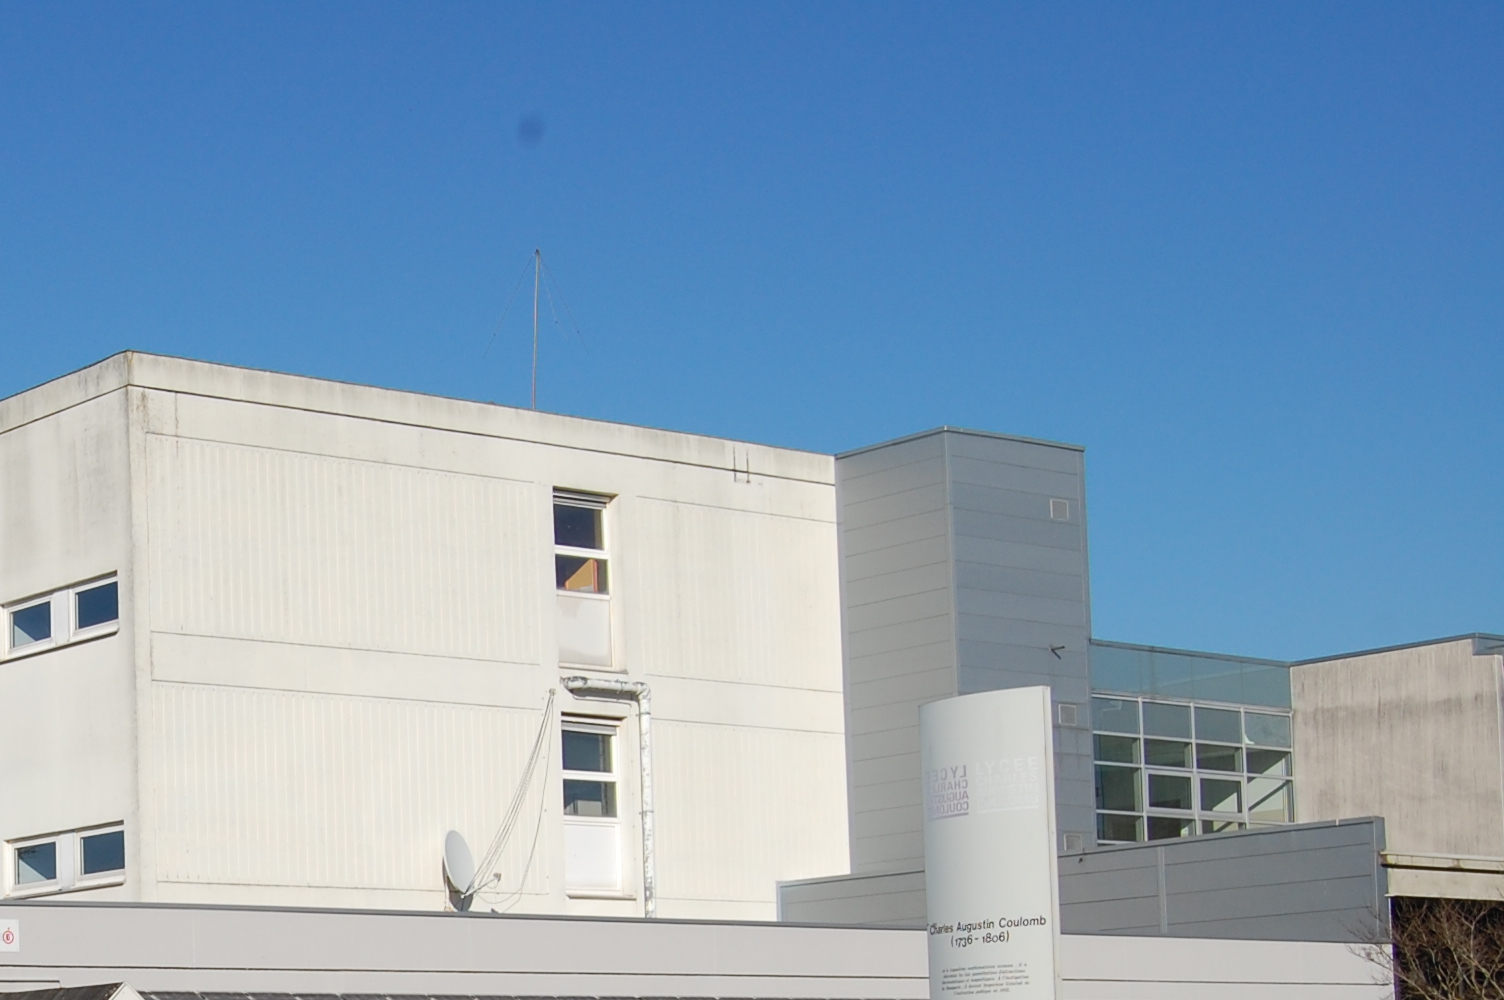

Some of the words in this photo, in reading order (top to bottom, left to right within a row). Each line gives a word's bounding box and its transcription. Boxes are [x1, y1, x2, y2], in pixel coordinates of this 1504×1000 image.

[929, 922, 954, 936] Charles
[956, 918, 995, 934] Augustin
[998, 914, 1047, 929] Coulomb
